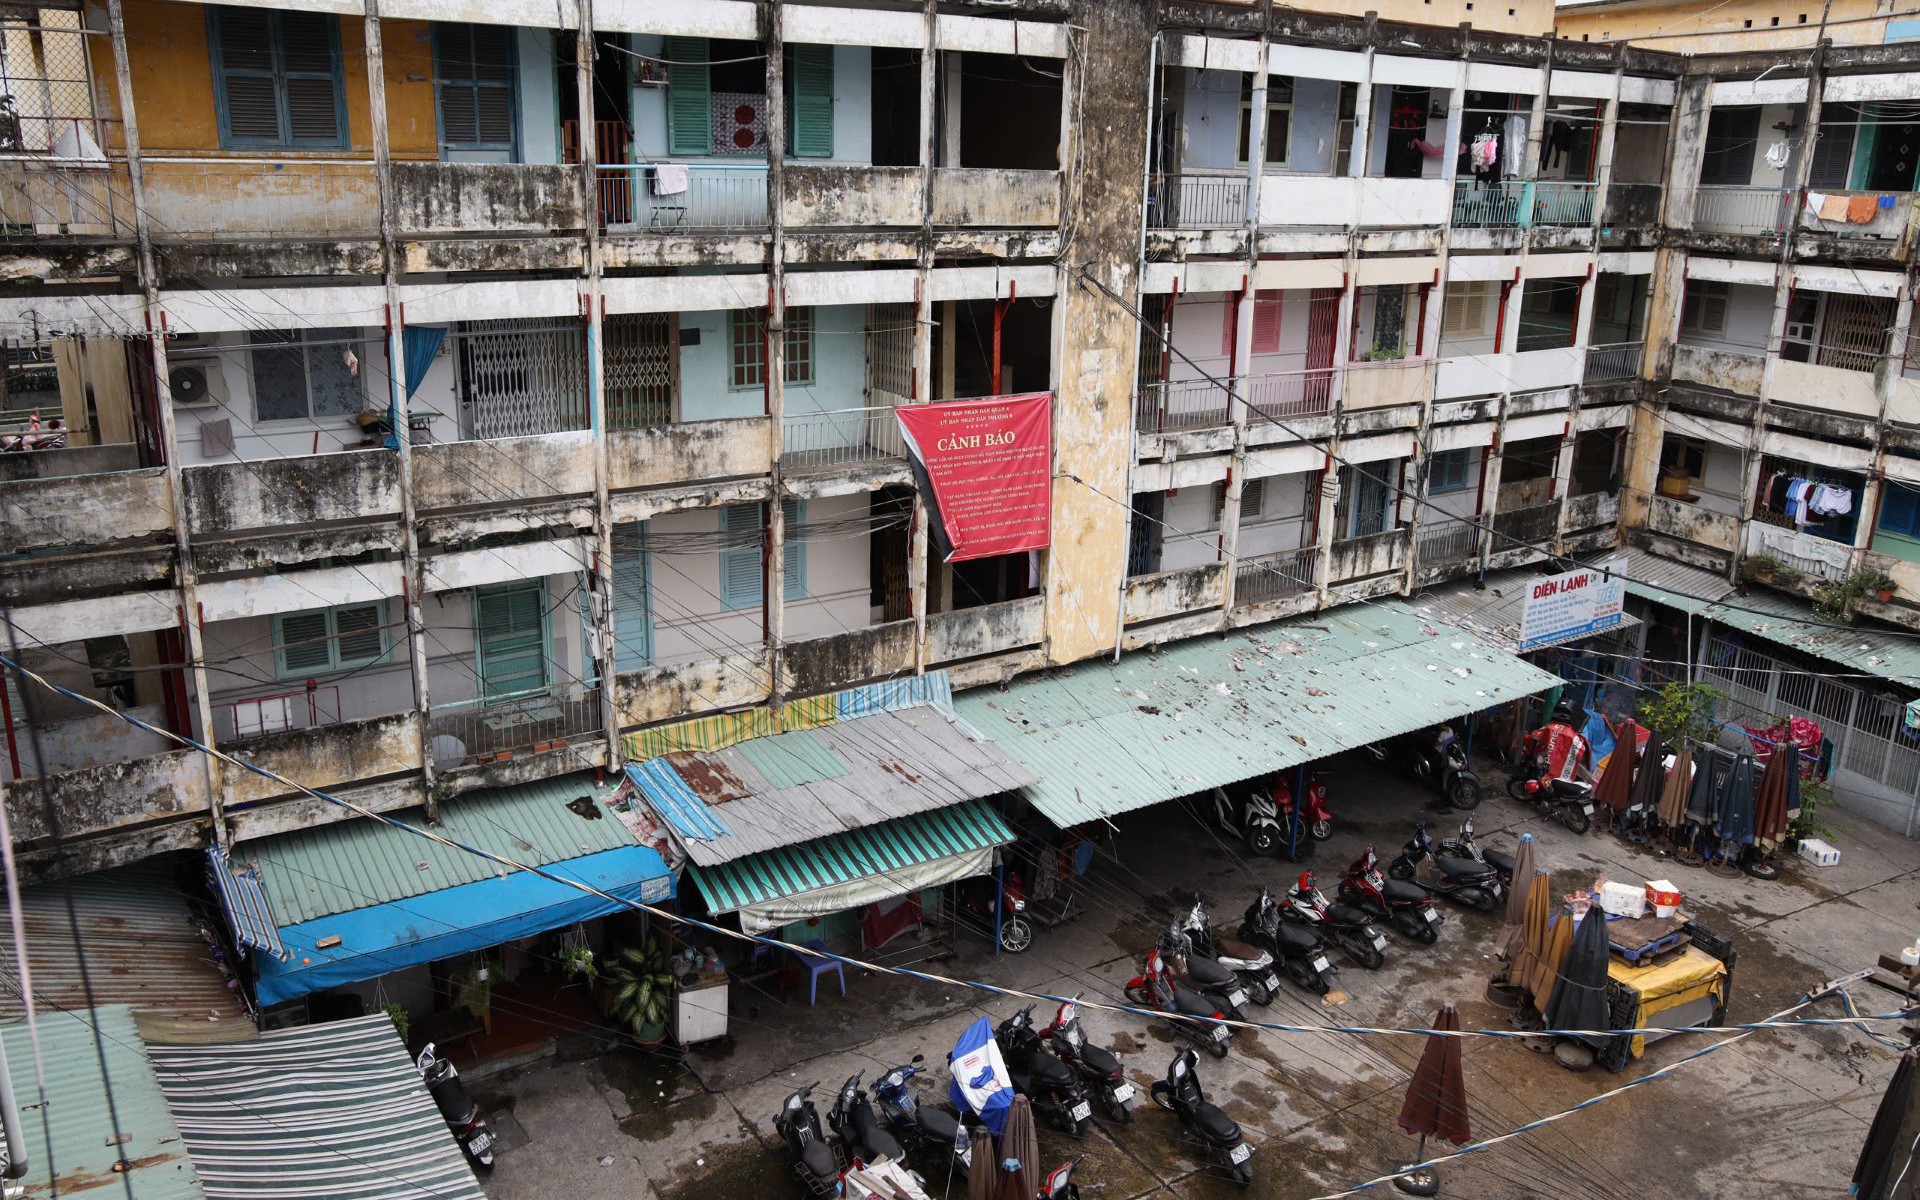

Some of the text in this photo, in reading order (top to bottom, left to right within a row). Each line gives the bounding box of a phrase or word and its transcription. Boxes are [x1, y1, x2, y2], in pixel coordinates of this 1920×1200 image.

[937, 428, 1016, 452] CẢNH BÁO
[1533, 580, 1558, 600] ĐIỆN
[1560, 574, 1588, 594] LẠNH
